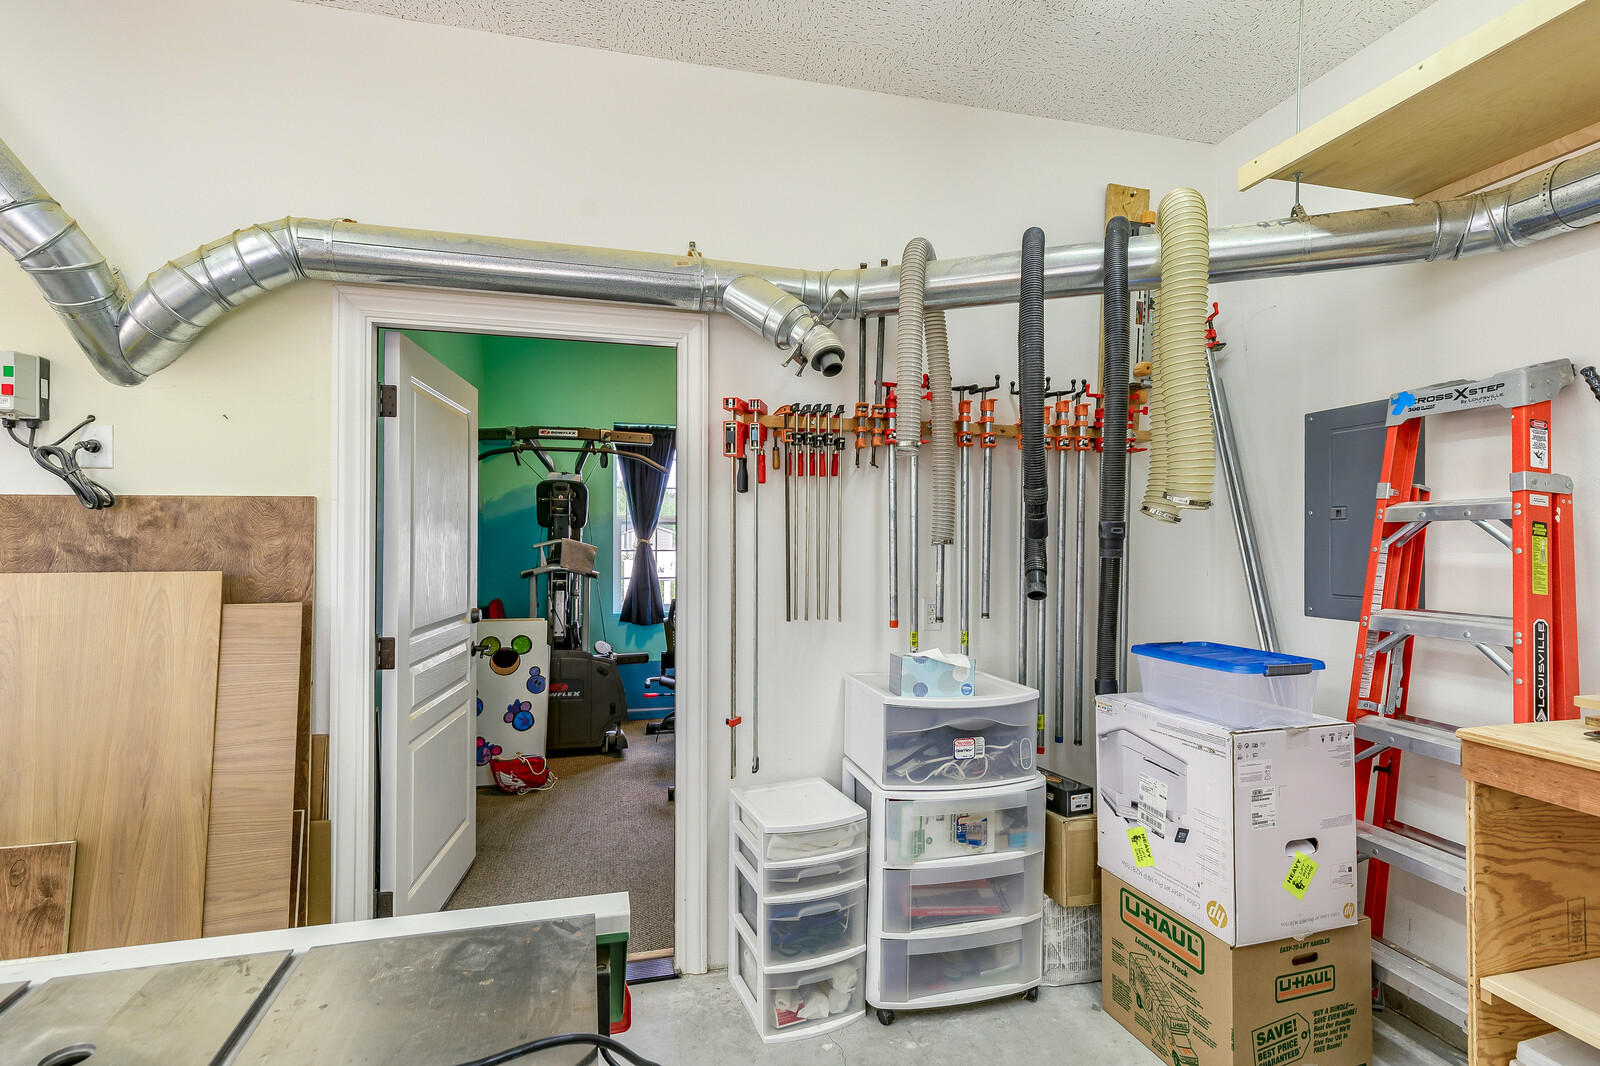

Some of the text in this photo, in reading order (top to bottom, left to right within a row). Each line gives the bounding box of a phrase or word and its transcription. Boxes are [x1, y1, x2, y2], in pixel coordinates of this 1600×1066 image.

[1141, 833, 1151, 858] HEAVY
[1287, 859, 1301, 883] HEAVY
[1125, 895, 1199, 957] U-HAUL
[1207, 901, 1227, 928] hp
[1135, 936, 1156, 957] Loading
[1157, 951, 1170, 965] Your
[1171, 961, 1188, 978] Truck
[1280, 937, 1330, 953] EASY-TO-LIFT HANDLES
[1280, 970, 1331, 992] U-HAUL
[1314, 1007, 1357, 1024] SAVE EVEN MORE!
[1257, 1019, 1297, 1046] SAVE!
[1314, 1031, 1328, 1039] Prices
[1258, 1038, 1298, 1061] BEST PRICE
